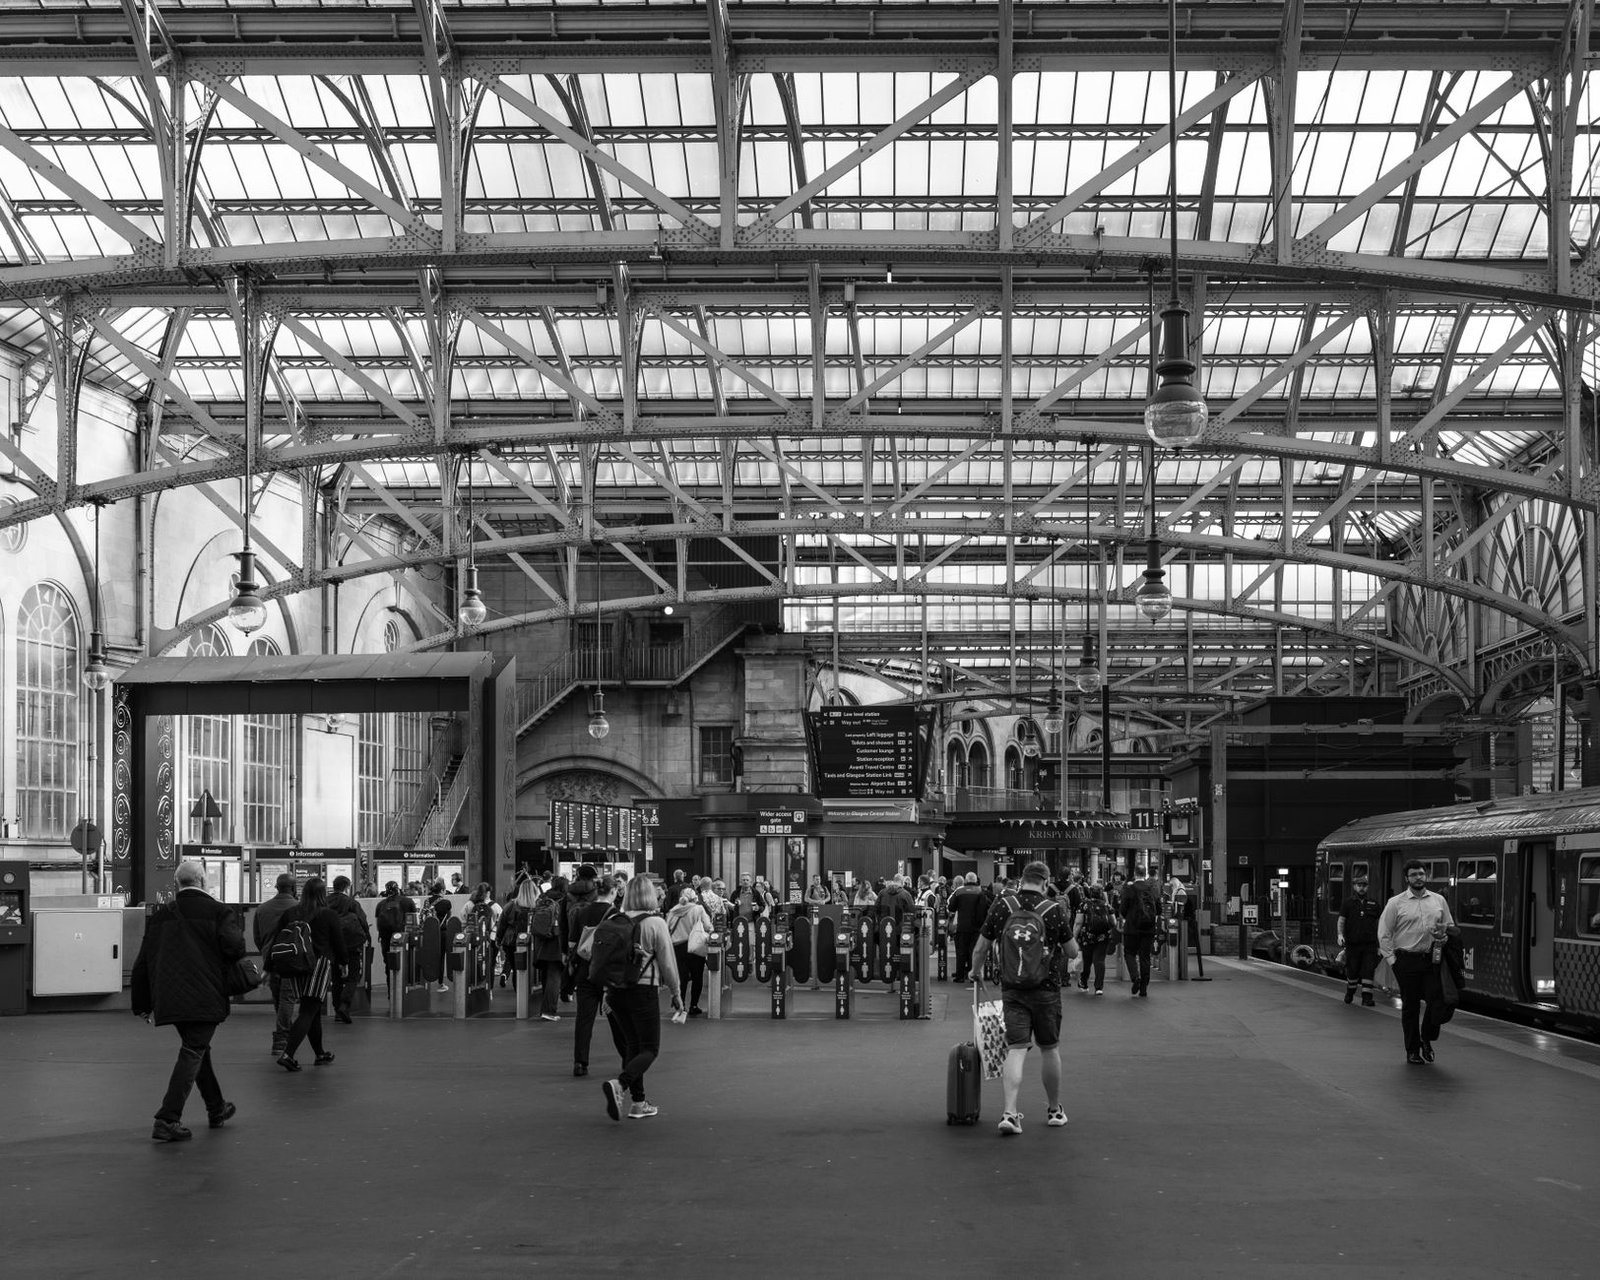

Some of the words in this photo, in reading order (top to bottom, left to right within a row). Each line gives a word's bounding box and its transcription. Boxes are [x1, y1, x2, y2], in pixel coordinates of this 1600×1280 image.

[1135, 812, 1149, 828] 11
[1029, 830, 1064, 839] KRISPY
[1065, 830, 1093, 839] KREME
